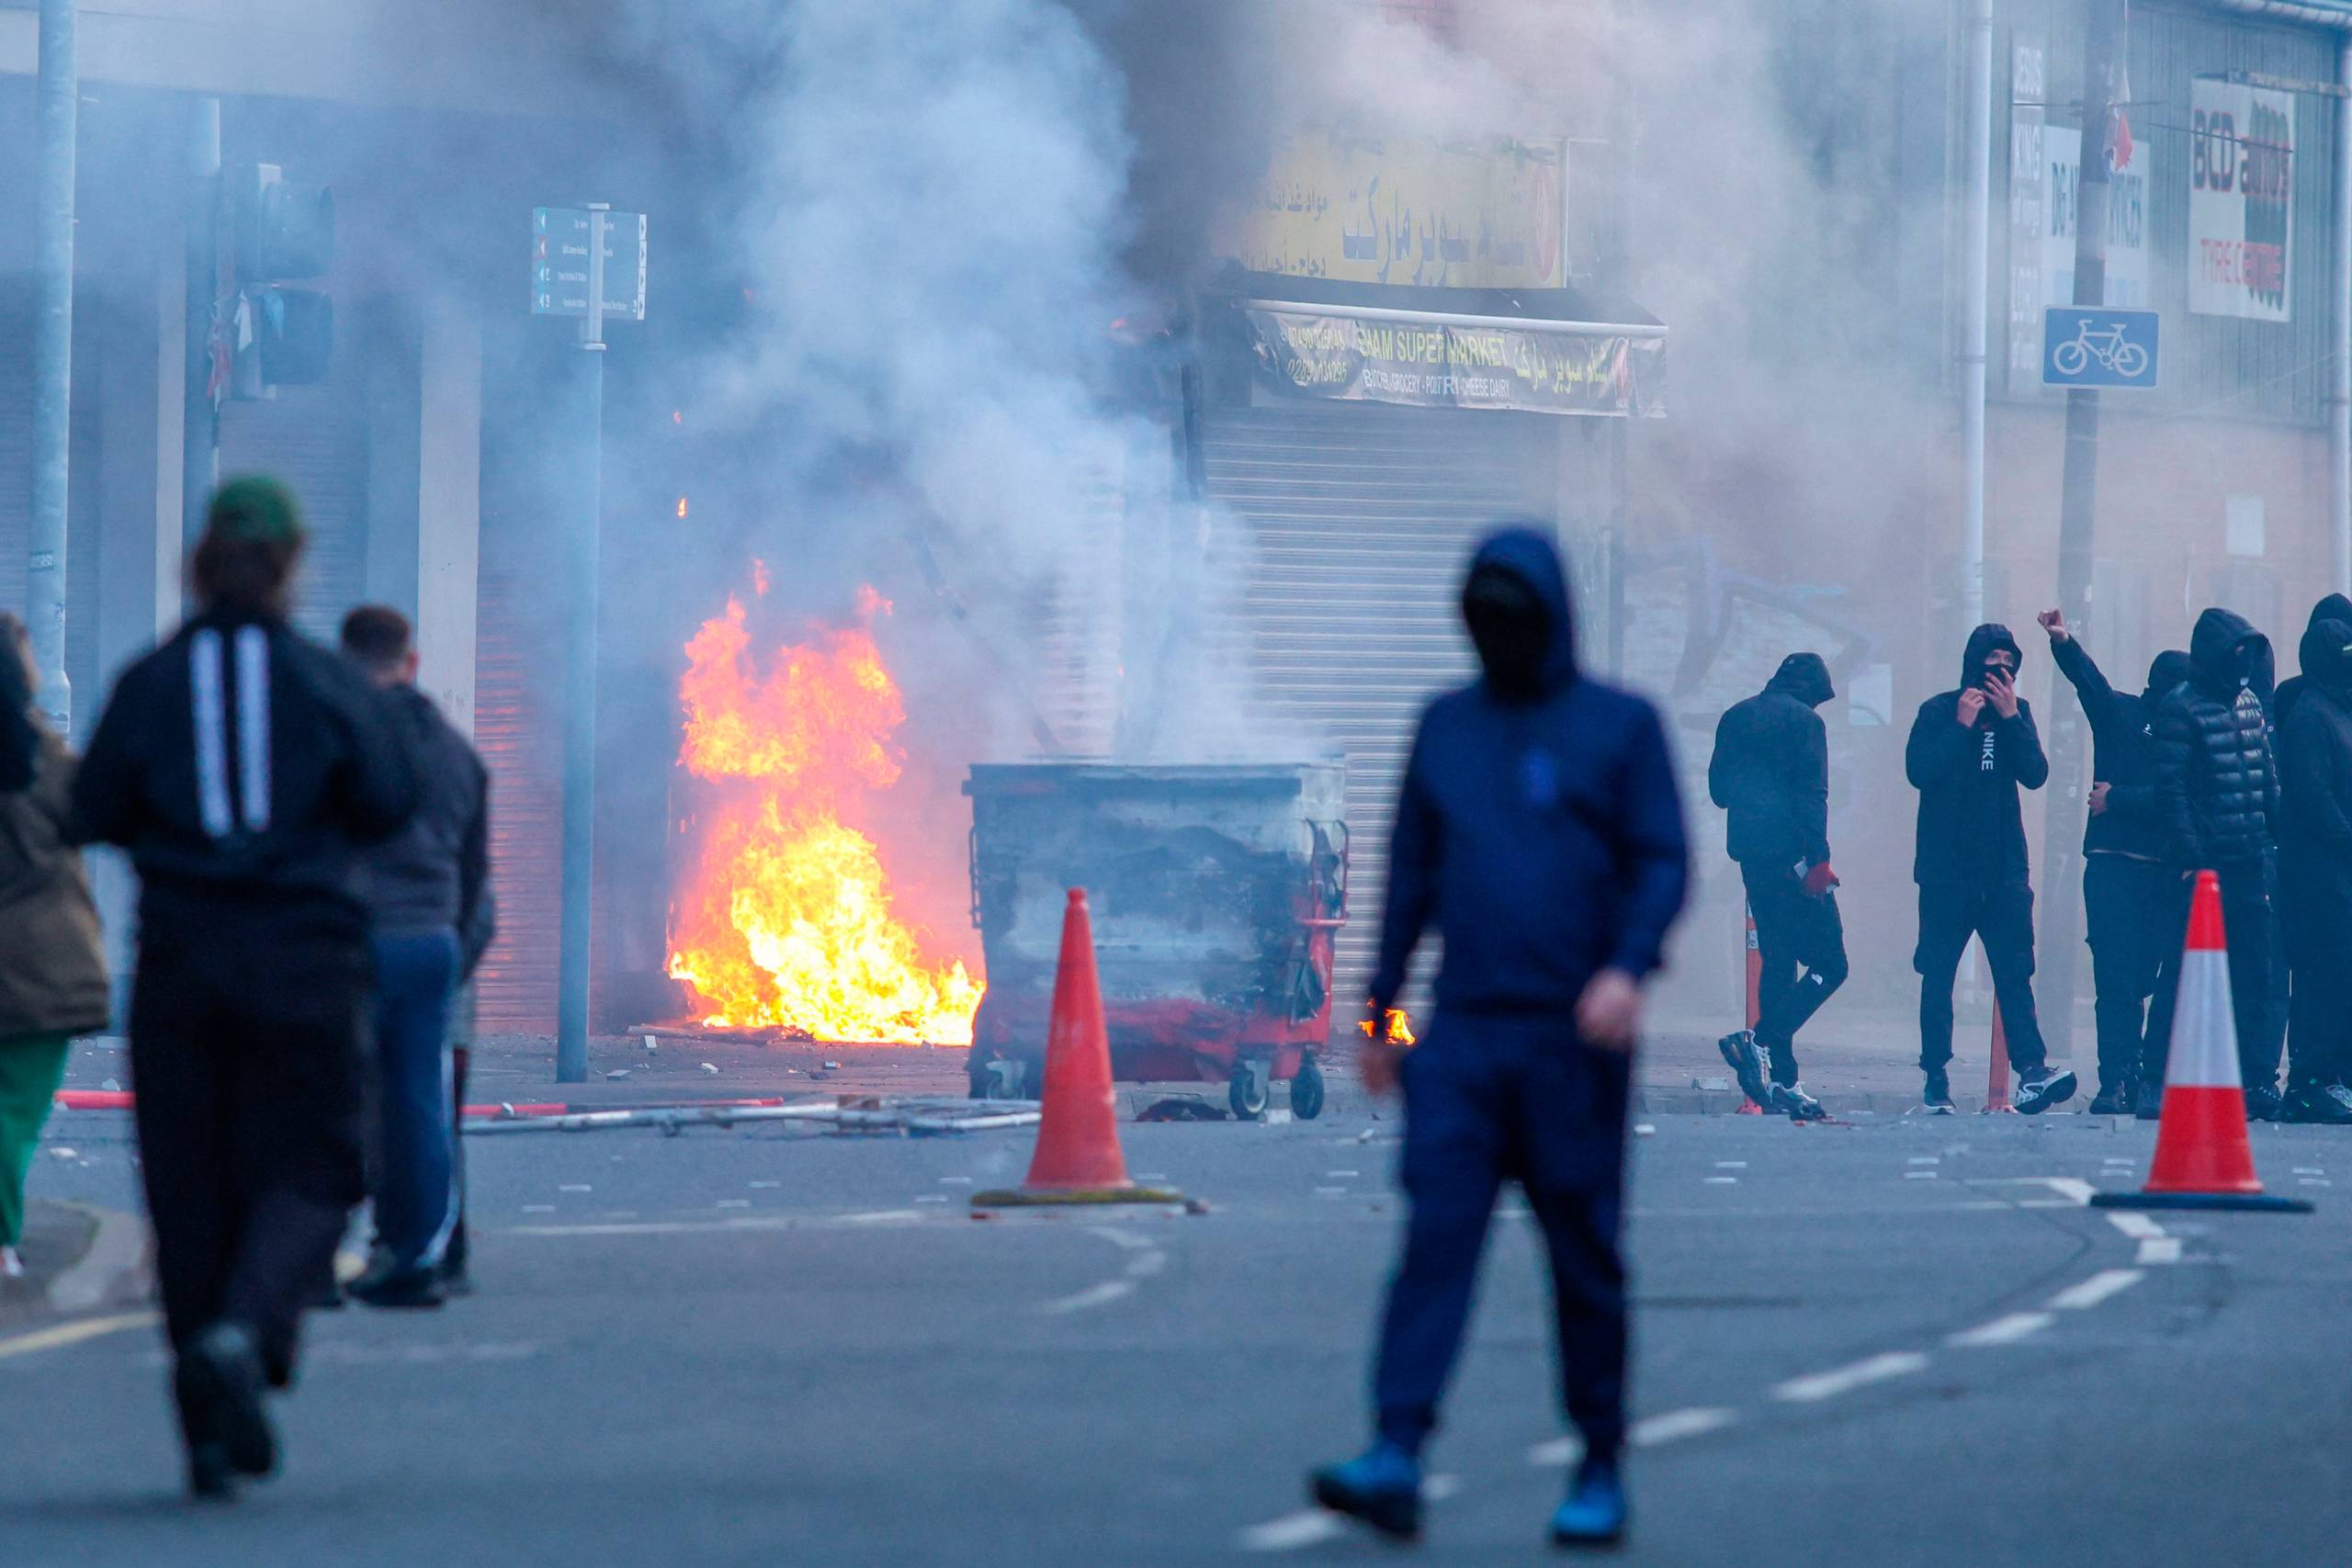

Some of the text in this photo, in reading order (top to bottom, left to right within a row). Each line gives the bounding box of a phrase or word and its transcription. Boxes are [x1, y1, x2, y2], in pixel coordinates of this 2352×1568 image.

[2014, 123, 2041, 181] KING
[2193, 107, 2236, 193] BCD
[1358, 327, 1508, 367] SHAM SUPER MARKET
[1490, 378, 1510, 397] DAIRY
[1982, 731, 1995, 771] NIKE
